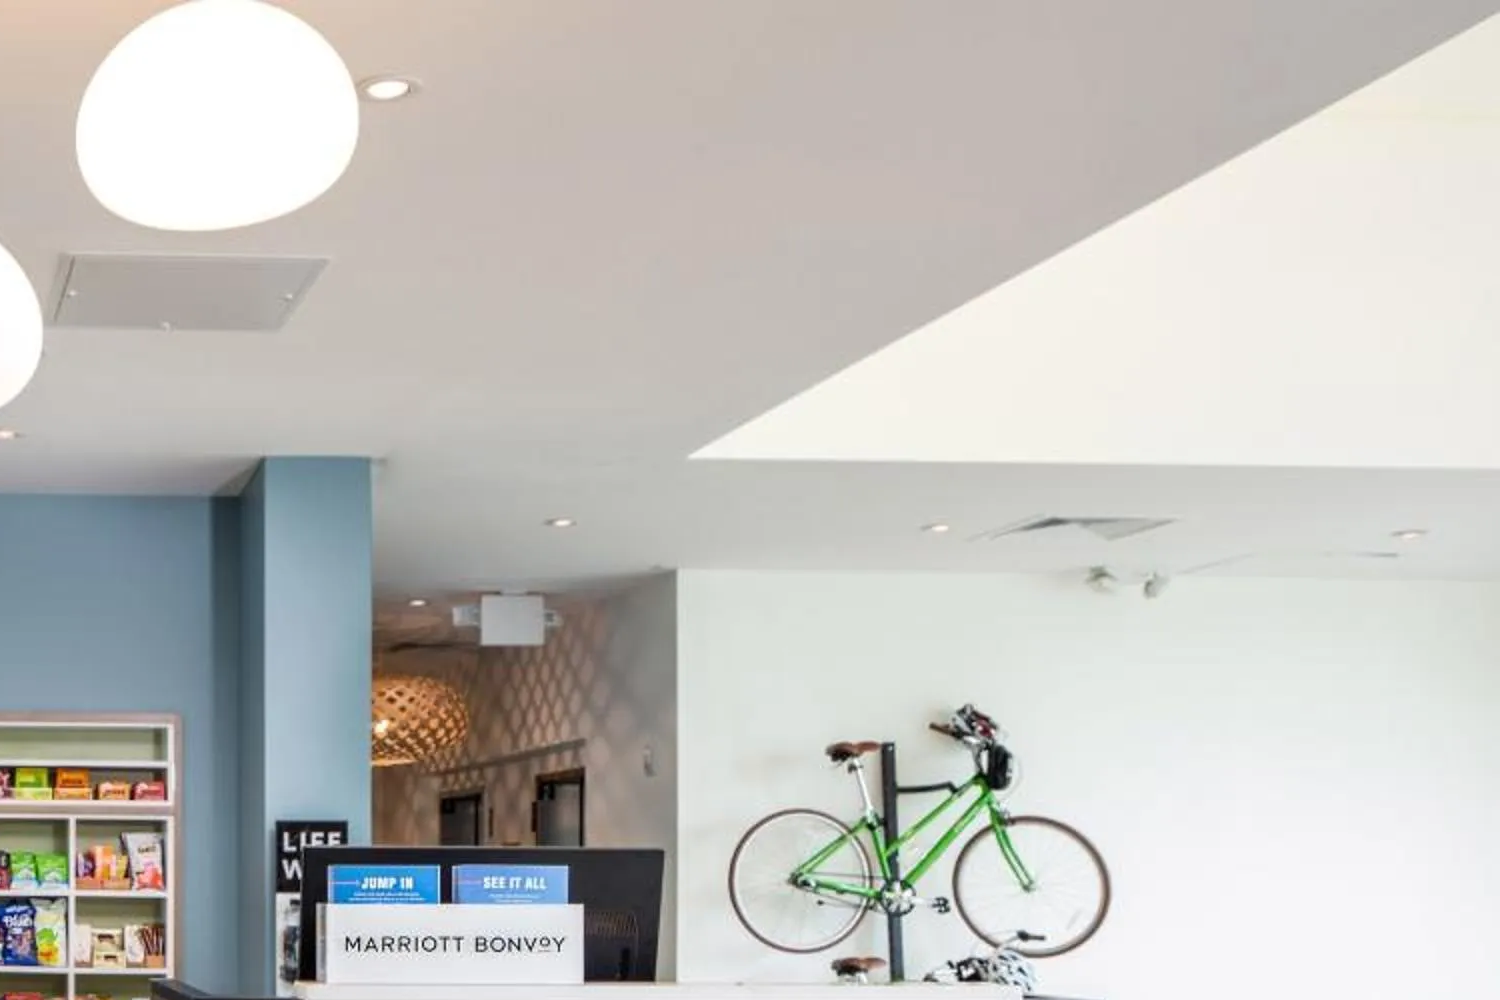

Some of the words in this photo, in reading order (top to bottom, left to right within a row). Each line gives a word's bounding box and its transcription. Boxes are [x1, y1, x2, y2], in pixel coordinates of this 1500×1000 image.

[361, 876, 397, 890] JUMP
[399, 876, 413, 890] IN
[483, 876, 507, 889] SEE
[509, 876, 522, 889] IT
[524, 876, 548, 890] ALL
[344, 935, 465, 953] MARRIOTT
[474, 935, 566, 953] BONVOY
